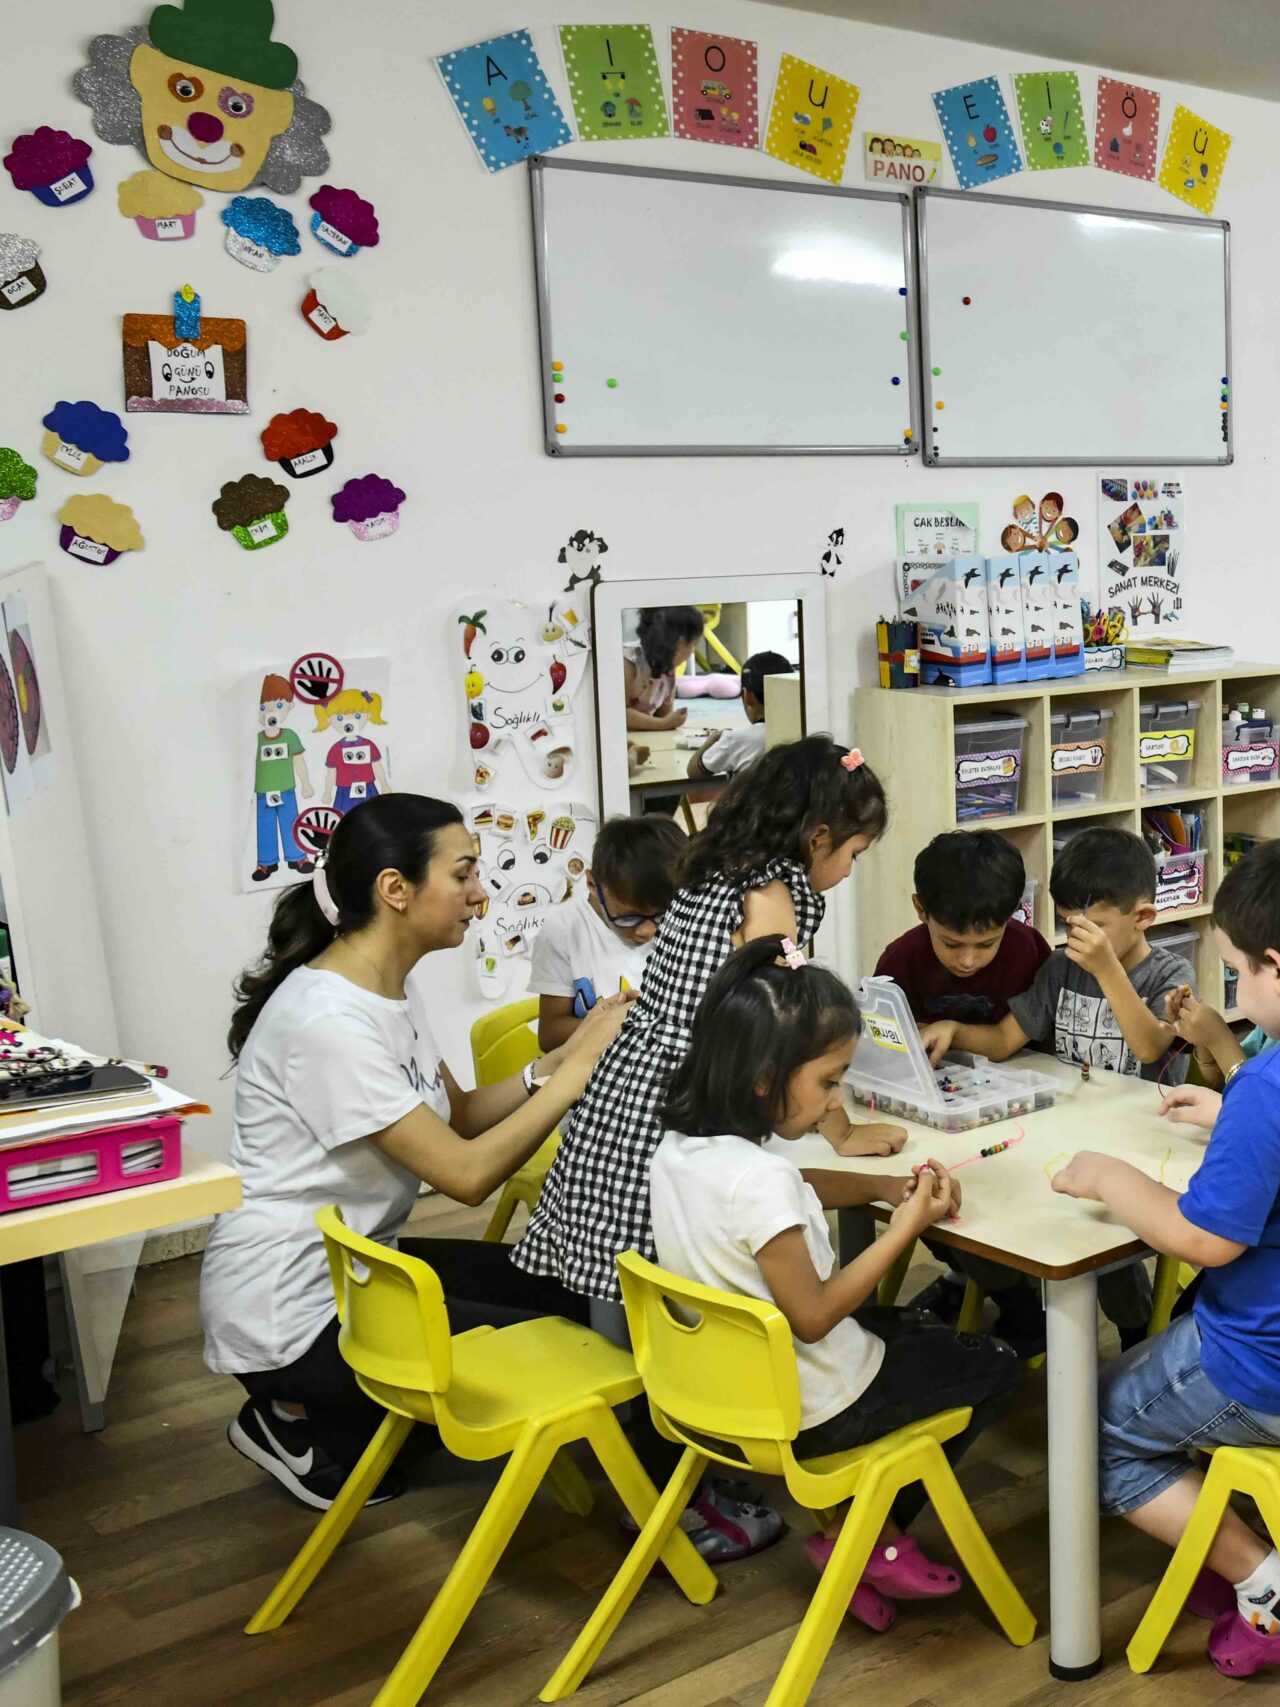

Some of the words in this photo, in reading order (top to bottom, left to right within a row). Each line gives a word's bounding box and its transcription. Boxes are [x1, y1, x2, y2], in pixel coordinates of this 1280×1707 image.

[606, 39, 614, 66] I
[704, 45, 726, 72] O
[486, 55, 508, 86] A
[963, 94, 980, 120] E
[1121, 91, 1137, 118] Ö
[873, 159, 925, 182] PANO
[157, 220, 177, 229] MART
[7, 281, 27, 295] OCAK
[169, 385, 210, 396] PANOSU
[1108, 576, 1138, 598] SANAT
[1140, 575, 1180, 595] MERKEZİ
[490, 707, 541, 729] Sağlıklı
[869, 1024, 903, 1046] Temel
